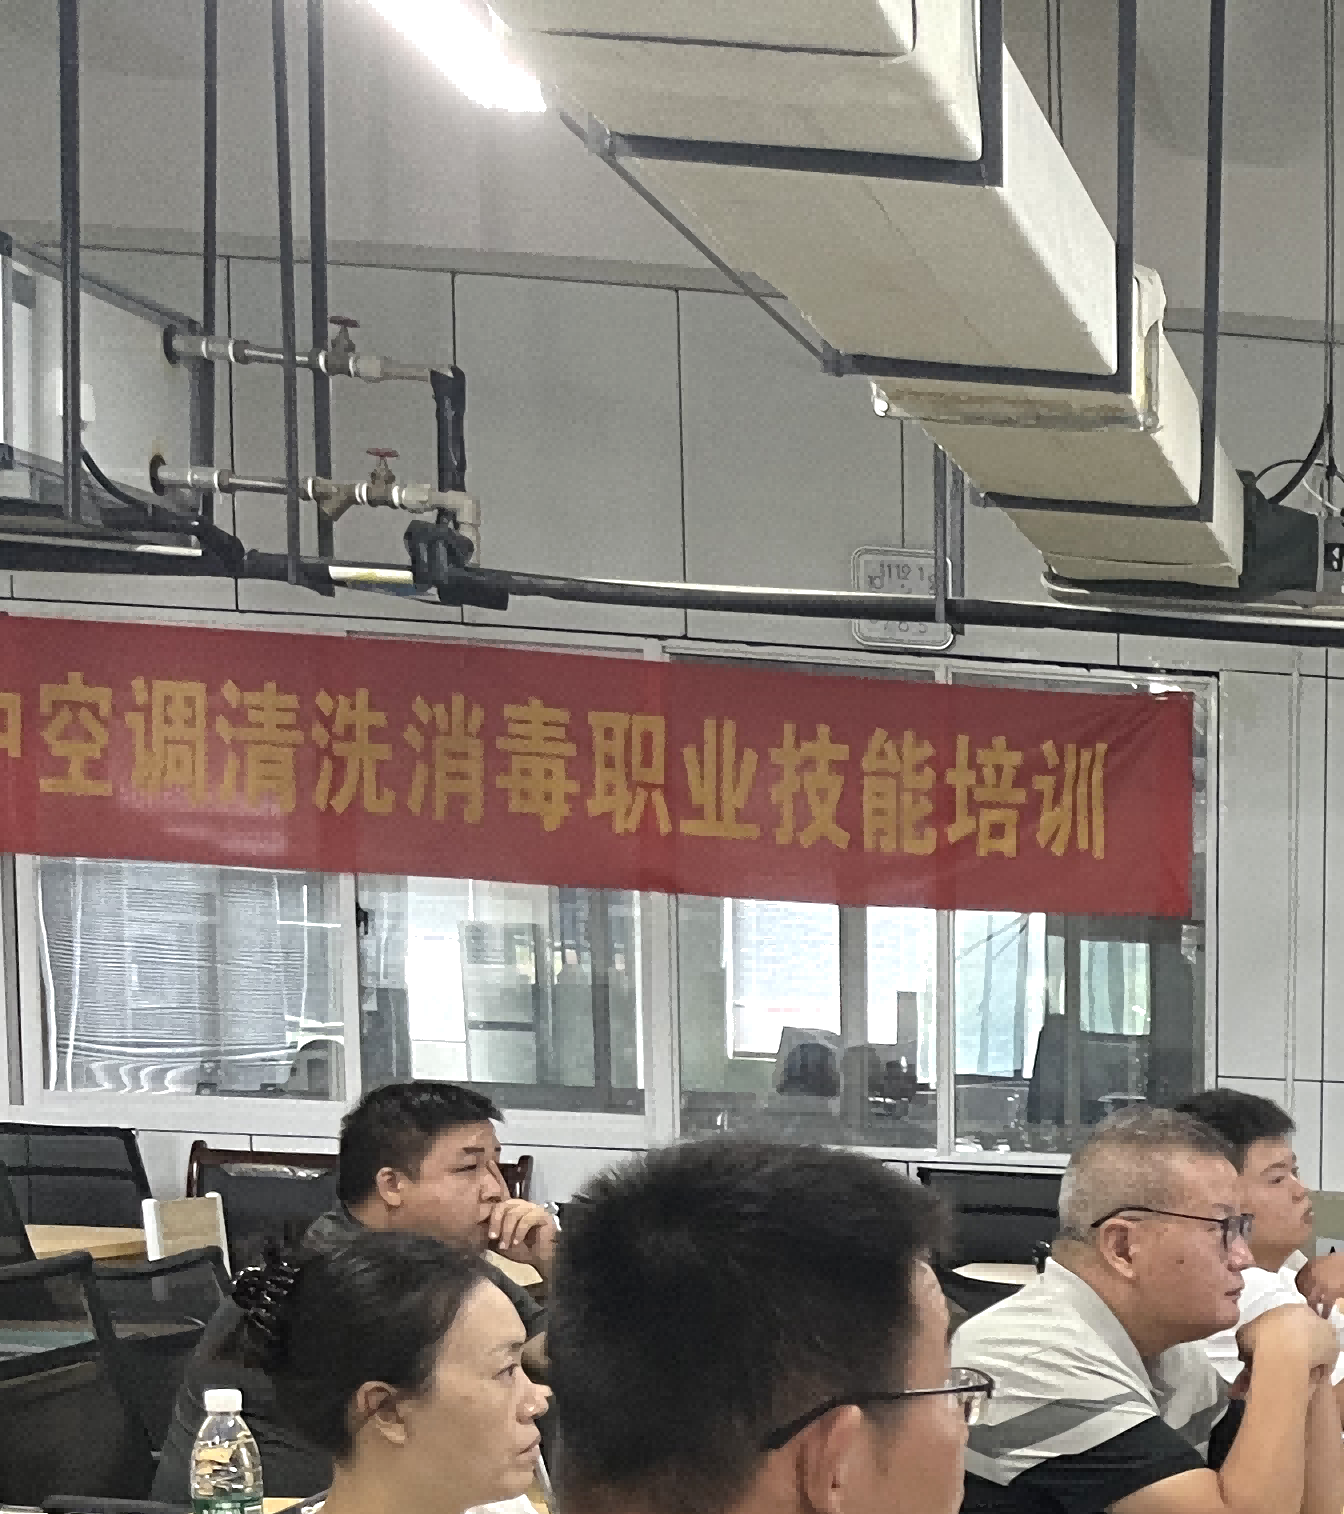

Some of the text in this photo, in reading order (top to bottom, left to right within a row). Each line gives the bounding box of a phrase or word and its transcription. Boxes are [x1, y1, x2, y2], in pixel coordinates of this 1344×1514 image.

[0, 671, 1108, 859] 空调清洗消毒职业技能培训
